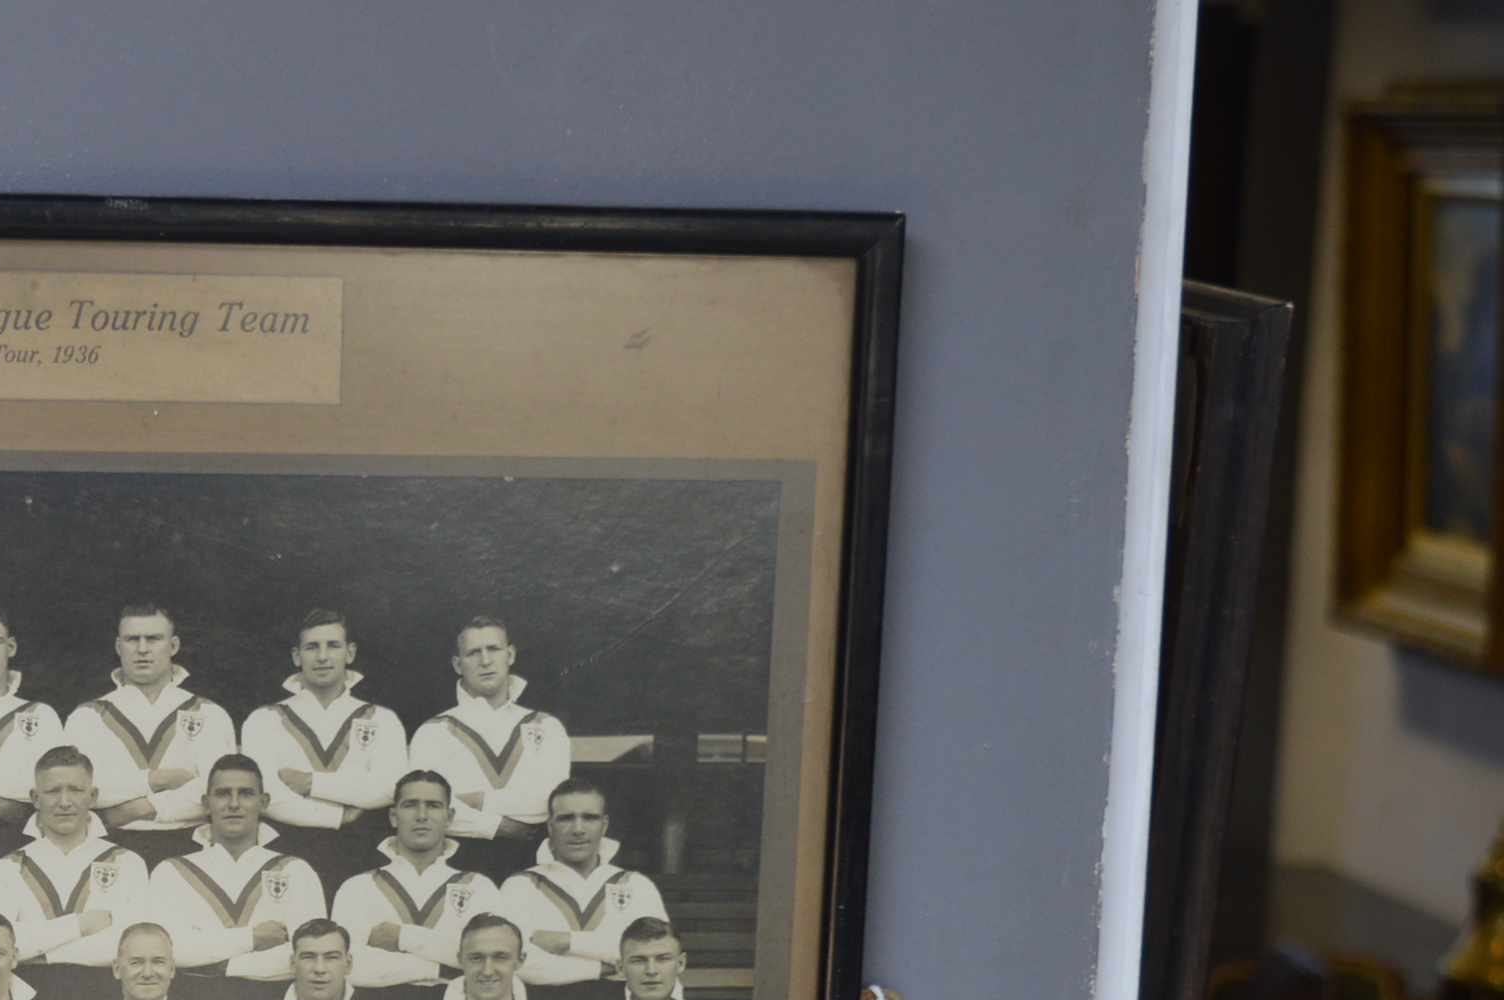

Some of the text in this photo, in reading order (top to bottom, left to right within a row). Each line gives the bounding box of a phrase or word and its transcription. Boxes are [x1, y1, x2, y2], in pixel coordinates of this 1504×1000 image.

[69, 300, 200, 338] Touring
[217, 302, 310, 334] Team
[51, 346, 102, 364] 1936
